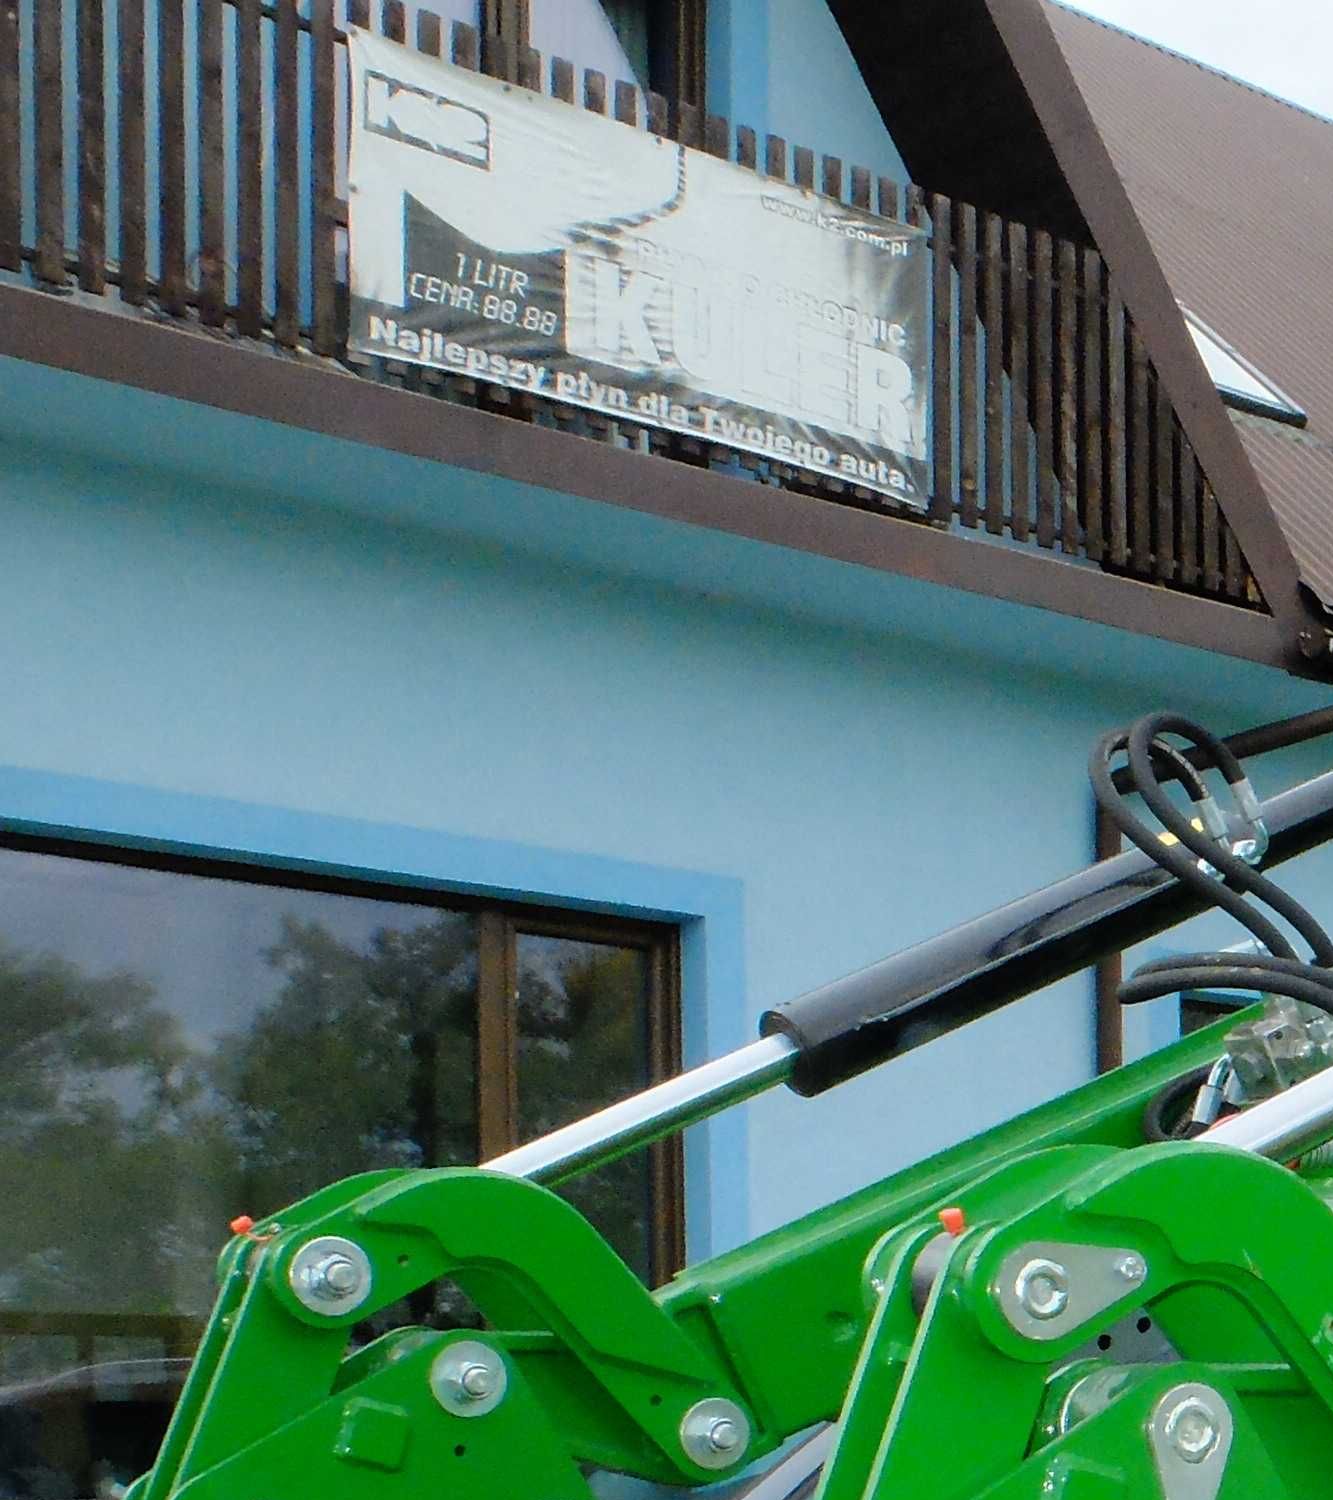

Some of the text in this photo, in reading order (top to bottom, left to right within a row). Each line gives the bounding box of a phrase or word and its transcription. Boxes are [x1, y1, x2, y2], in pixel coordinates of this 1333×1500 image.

[762, 195, 908, 257] www.k2.com.pl
[456, 252, 529, 299] 1 LITR
[367, 314, 546, 388] Najlepszy
[638, 391, 690, 426] dla
[699, 405, 831, 467] Twojego
[838, 451, 916, 494] auta.
